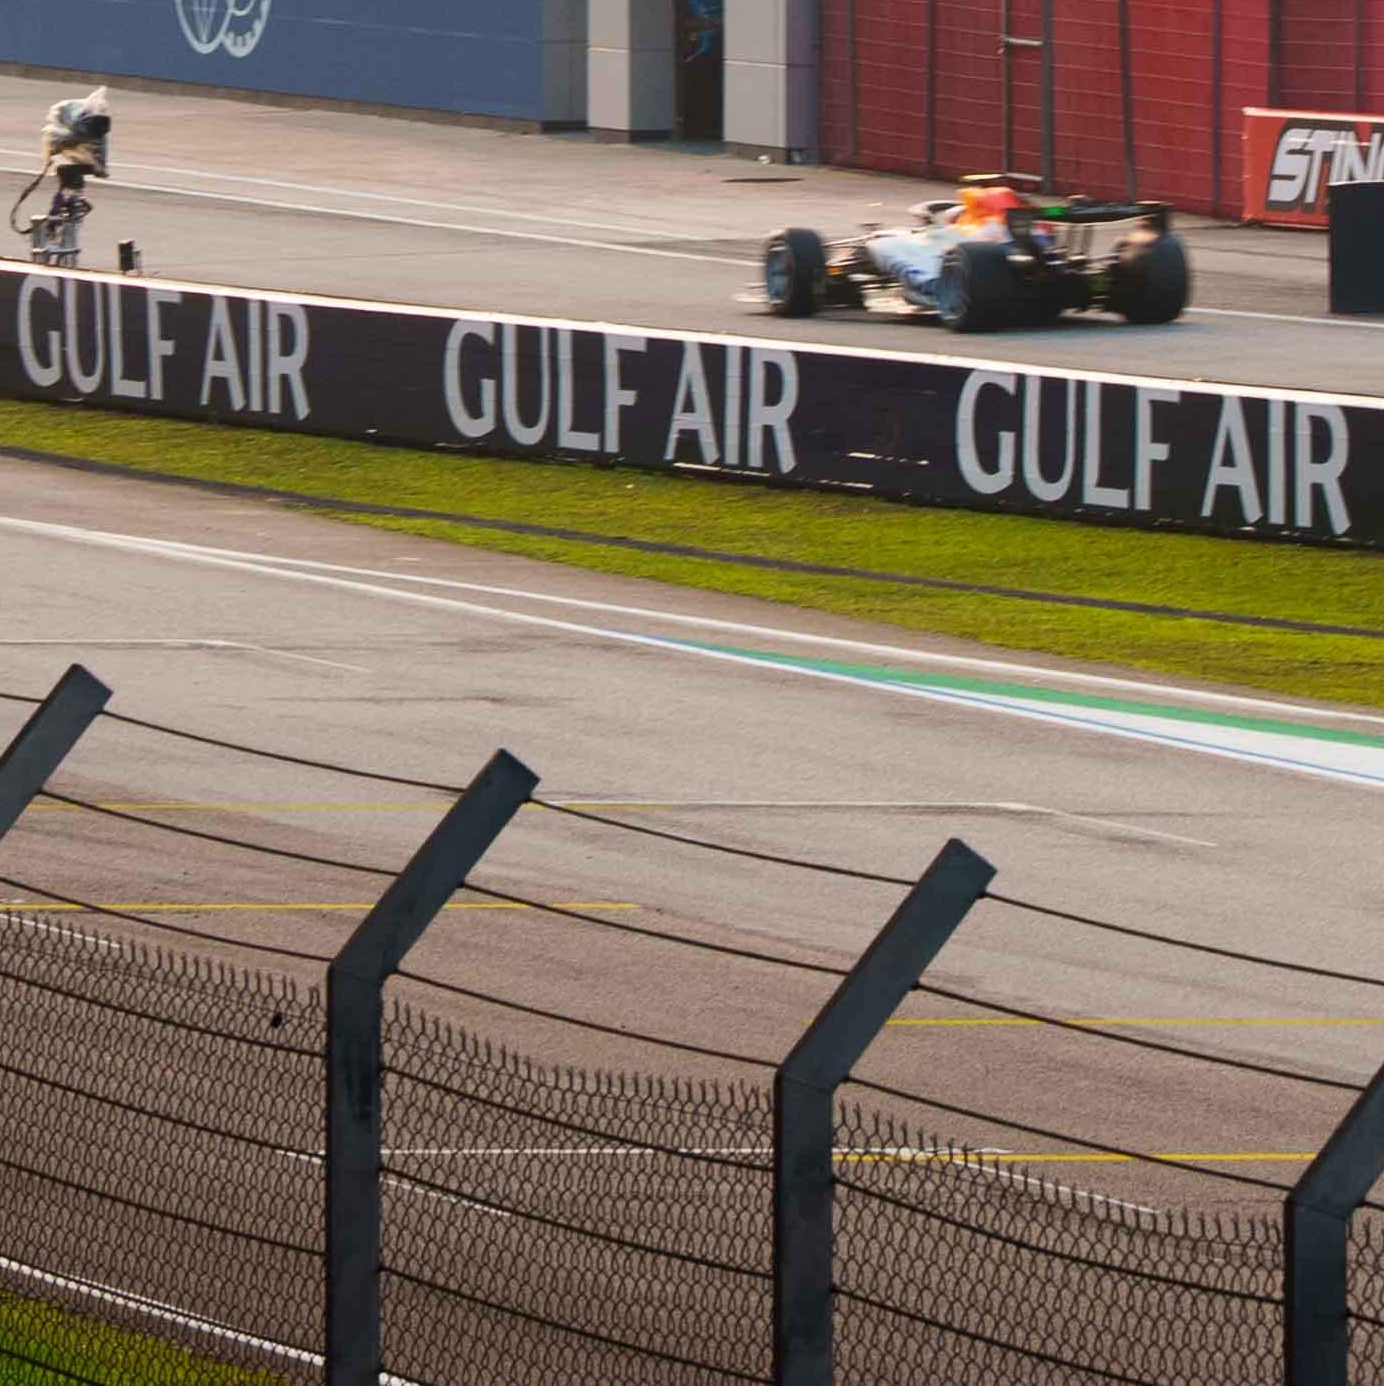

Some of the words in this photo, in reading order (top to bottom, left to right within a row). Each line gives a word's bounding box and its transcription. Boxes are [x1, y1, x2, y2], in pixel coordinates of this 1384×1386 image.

[18, 275, 187, 402] GULF
[201, 296, 311, 422] AIR
[444, 319, 647, 454] GULF
[664, 341, 799, 475] AIR
[957, 369, 1181, 512] GULF
[1202, 395, 1353, 536] AIR
